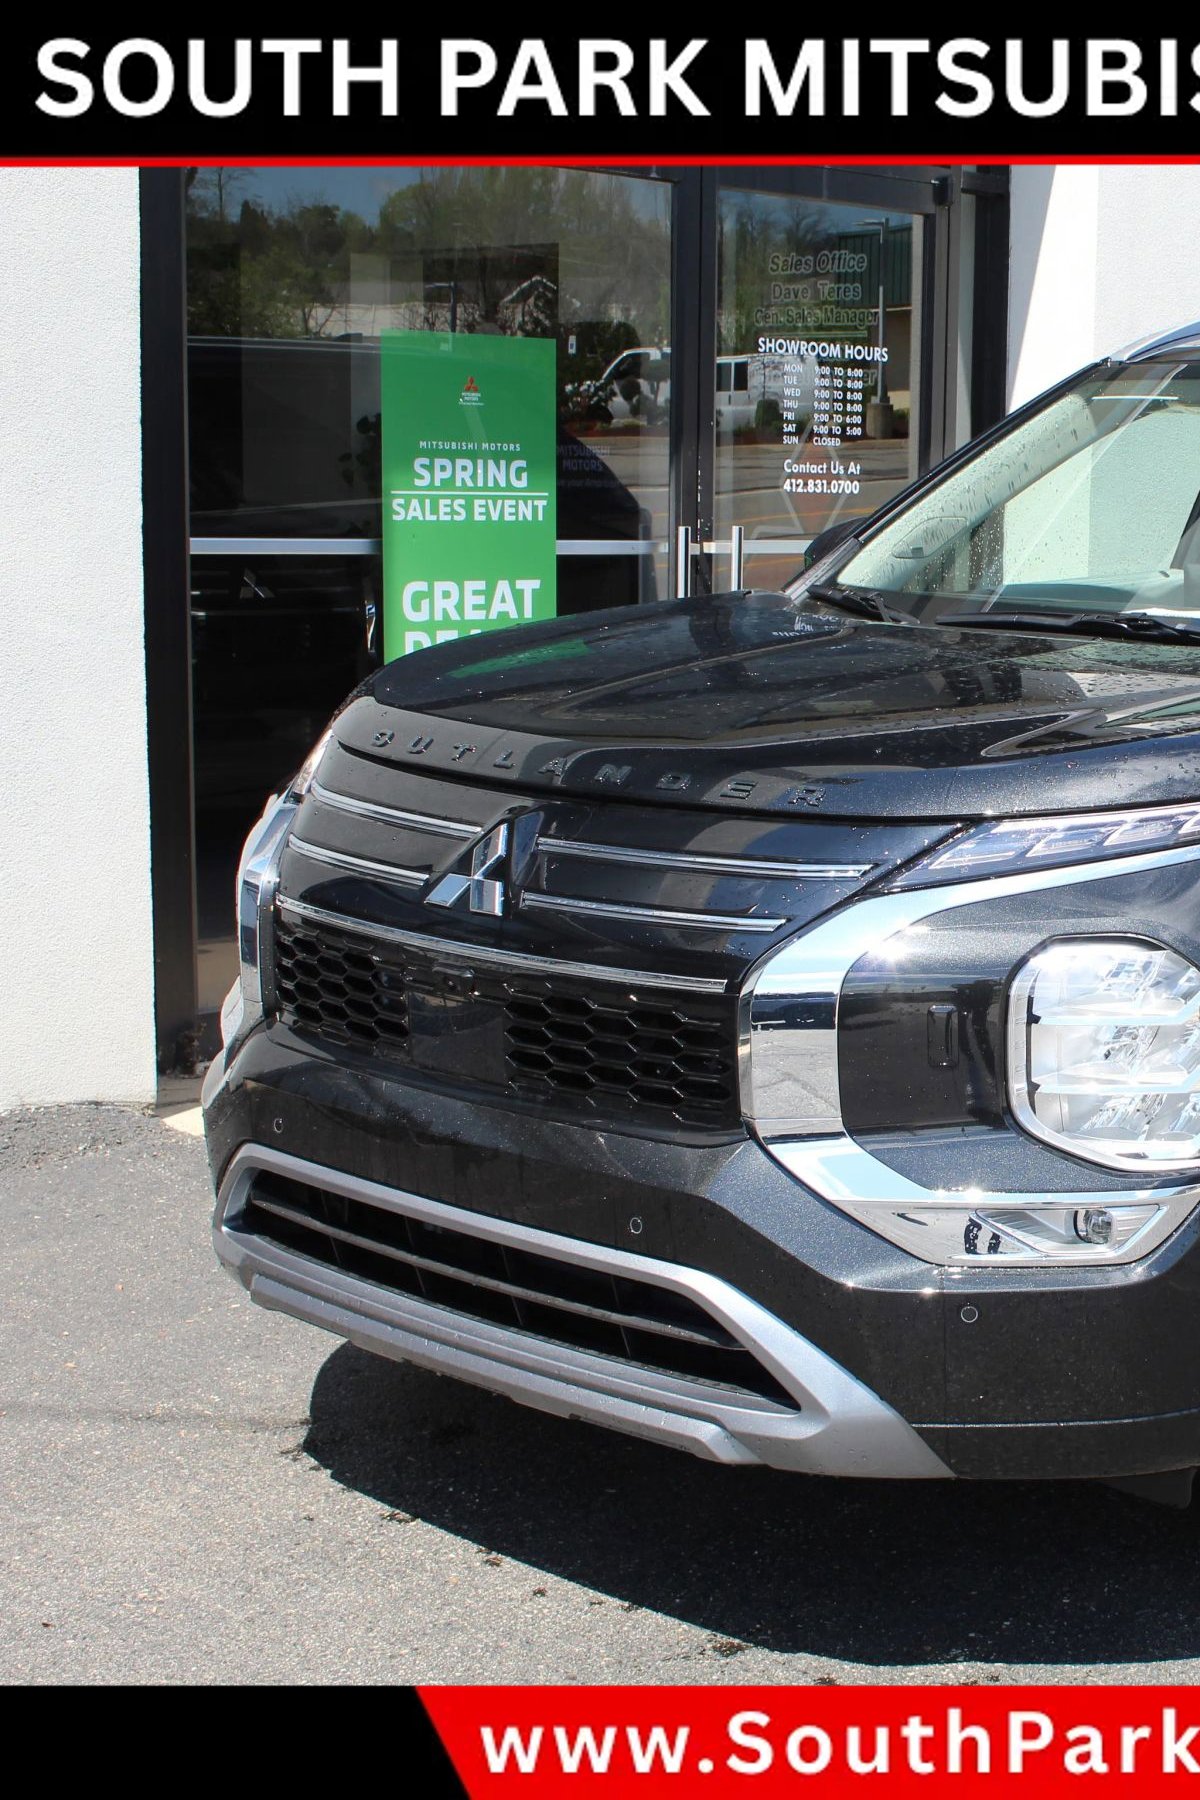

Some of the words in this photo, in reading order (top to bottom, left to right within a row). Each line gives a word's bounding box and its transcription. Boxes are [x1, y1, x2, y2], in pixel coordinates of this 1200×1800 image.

[769, 253, 814, 274] Sales
[816, 250, 867, 273] Office
[771, 282, 810, 301] Dave
[817, 280, 862, 301] Teres
[754, 307, 784, 326] Gen.
[785, 307, 820, 326] Sales
[822, 306, 879, 330] Manager
[758, 337, 841, 359] SHOWROOM
[845, 345, 888, 363] HOURS
[784, 364, 802, 373] MON
[814, 366, 830, 375] 9:00
[834, 367, 844, 376] TO
[847, 368, 863, 378] 8:00
[784, 376, 798, 385] TUE
[814, 378, 830, 387] 9:00
[833, 379, 843, 388] TO
[846, 380, 863, 389] 8:00
[784, 388, 800, 397] WED
[814, 390, 830, 399] 9:00
[833, 391, 843, 400] TO
[846, 392, 862, 401] 8:00
[784, 400, 798, 409] THU
[814, 402, 830, 411] 9:00
[833, 402, 843, 411] TO
[846, 403, 862, 412] 8:00
[784, 412, 794, 420] FRI
[814, 414, 829, 422] 9:00
[833, 414, 842, 423] TO
[846, 415, 862, 424] 6:00
[783, 424, 796, 433] SAT
[813, 425, 828, 434] 9:00
[832, 426, 842, 435] TO
[846, 427, 862, 436] 5:00
[420, 440, 478, 450] MITSUBISHI
[482, 442, 521, 452] MOTORS
[782, 435, 798, 444] SUN
[813, 436, 841, 446] CLOSED
[414, 457, 528, 489] SPRING
[784, 459, 827, 476] Contact
[830, 460, 845, 474] Us
[848, 461, 861, 476] At
[783, 478, 860, 494] 412.831.0700
[392, 498, 466, 522] SALES
[473, 499, 548, 522] EVENT
[402, 579, 541, 623] GREAT
[370, 729, 826, 807] OUTLANDER
